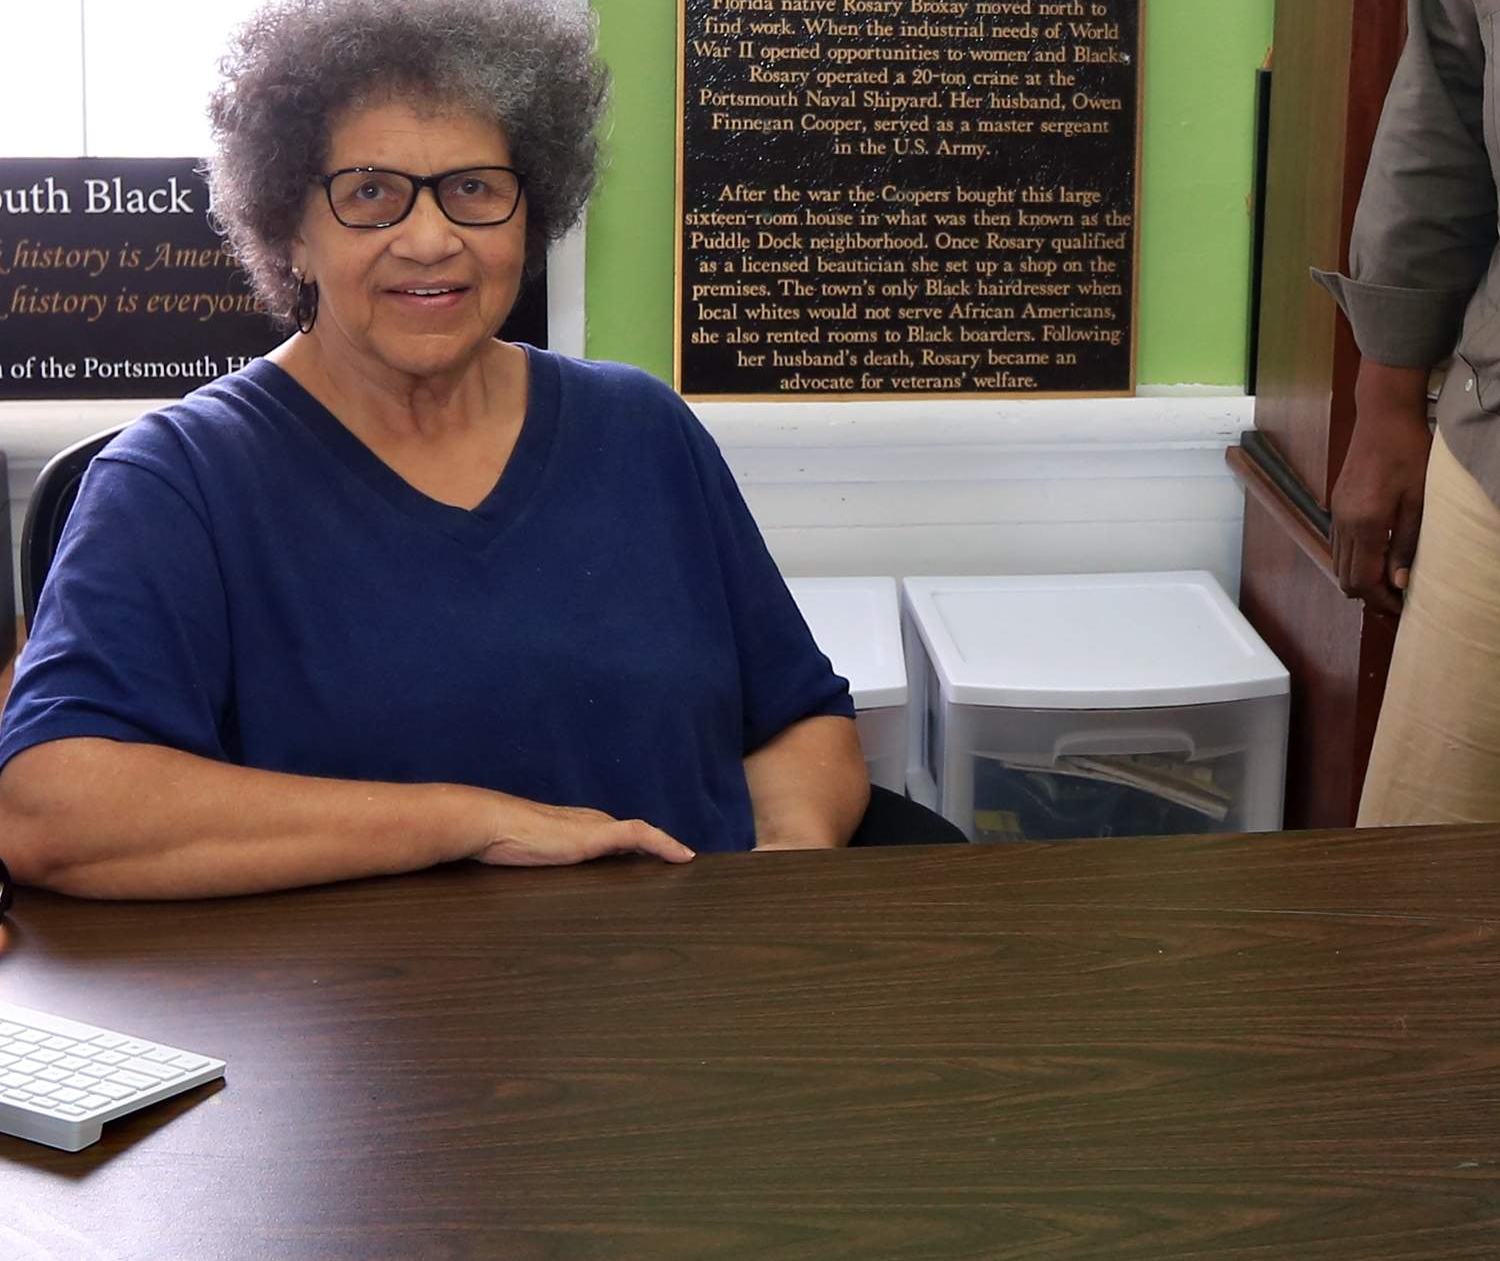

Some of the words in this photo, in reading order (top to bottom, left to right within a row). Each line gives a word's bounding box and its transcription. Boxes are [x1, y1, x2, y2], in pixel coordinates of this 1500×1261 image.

[782, 0, 836, 11] native
[977, 2, 1031, 15] moved
[1040, 1, 1084, 15] north
[1091, 3, 1106, 16] to
[707, 17, 741, 34] find
[750, 19, 796, 35] work.
[805, 18, 859, 36] When
[867, 22, 893, 36] the
[902, 23, 984, 38] industrial
[992, 25, 1038, 38] needs
[1044, 23, 1060, 39] of
[1072, 24, 1118, 39] World
[694, 43, 730, 58] War
[740, 42, 752, 58] II
[761, 43, 820, 61] opened
[828, 48, 940, 62] opportunities
[948, 50, 963, 61] to
[971, 50, 1028, 62] women
[1036, 48, 1066, 62] and
[751, 66, 808, 83] Rosary
[817, 71, 888, 86] operated
[896, 73, 906, 83] a
[912, 69, 966, 84] 20-ton
[974, 74, 1017, 85] crane
[1027, 75, 1040, 86] at
[1051, 70, 1074, 86] the
[701, 89, 798, 106] Portsmouth
[807, 92, 855, 107] Naval
[864, 92, 942, 110] Shipyard.
[950, 92, 981, 108] Her
[990, 93, 1065, 110] husband,
[1072, 94, 1120, 110] Owen
[712, 113, 793, 130] Finnegan
[801, 114, 867, 132] Cooper,
[874, 119, 929, 131] served
[938, 121, 954, 132] as
[961, 122, 970, 131] a
[979, 121, 1030, 132] master
[1041, 120, 1109, 135] sergeant
[835, 141, 851, 154] in
[860, 142, 887, 154] the
[895, 140, 929, 156] U.S.
[938, 141, 990, 156] Army.
[84, 176, 194, 214] Black
[720, 185, 764, 202] After
[774, 188, 800, 202] the
[808, 191, 840, 202] war
[848, 190, 874, 202] the
[882, 185, 949, 204] Coopers
[957, 188, 1013, 206] bought
[1022, 188, 1052, 202] this
[1061, 187, 1100, 204] large
[685, 210, 798, 226] sixteen-room
[807, 214, 852, 226] house
[860, 214, 877, 225] in
[886, 212, 927, 226] what
[936, 214, 966, 226] was
[975, 214, 1011, 226] then
[1019, 214, 1074, 226] known
[1083, 216, 1098, 226] as
[1106, 214, 1131, 226] the
[692, 232, 750, 249] Puddle
[758, 232, 802, 249] Dock
[811, 234, 928, 252] neighborhood.
[936, 236, 979, 248] Once
[987, 232, 1043, 249] Rosary
[1052, 235, 1124, 251] qualified
[13, 239, 110, 277] history
[119, 241, 141, 268] is
[699, 262, 717, 273] as
[724, 261, 734, 272] a
[743, 260, 809, 272] licensed
[818, 258, 904, 272] beautician
[912, 261, 938, 272] she
[946, 262, 966, 272] set
[976, 262, 997, 276] up
[1005, 262, 1012, 272] a
[1021, 260, 1057, 274] shop
[1063, 262, 1082, 272] on
[1090, 258, 1116, 272] the
[693, 283, 771, 300] premises.
[778, 279, 814, 296] The
[822, 281, 876, 296] town's
[882, 284, 917, 297] only
[926, 279, 969, 296] Black
[978, 282, 1070, 296] hairdresser
[1079, 283, 1121, 294] when
[10, 284, 108, 322] history
[116, 286, 139, 314] is
[699, 306, 736, 320] local
[746, 306, 800, 320] whites
[808, 306, 856, 319] would
[866, 307, 890, 319] not
[899, 308, 942, 318] serve
[951, 304, 1014, 318] African
[1022, 305, 1116, 321] Americans,
[691, 331, 719, 344] she
[727, 328, 760, 343] also
[768, 328, 819, 343] rented
[828, 332, 878, 342] rooms
[885, 330, 900, 342] to
[908, 326, 952, 342] Black
[960, 329, 1036, 342] boarders.
[1044, 325, 1120, 344] Following
[10, 355, 36, 378] of
[41, 355, 76, 378] the
[84, 355, 219, 378] Portsmouth
[738, 351, 765, 368] her
[773, 350, 857, 366] husband's
[864, 351, 914, 368] death,
[922, 349, 980, 365] Rosary
[988, 352, 1049, 365] became
[1056, 354, 1076, 364] an
[780, 375, 854, 390] advocate
[861, 374, 883, 389] for
[892, 372, 967, 389] veterans'
[974, 374, 1038, 388] welfare.
